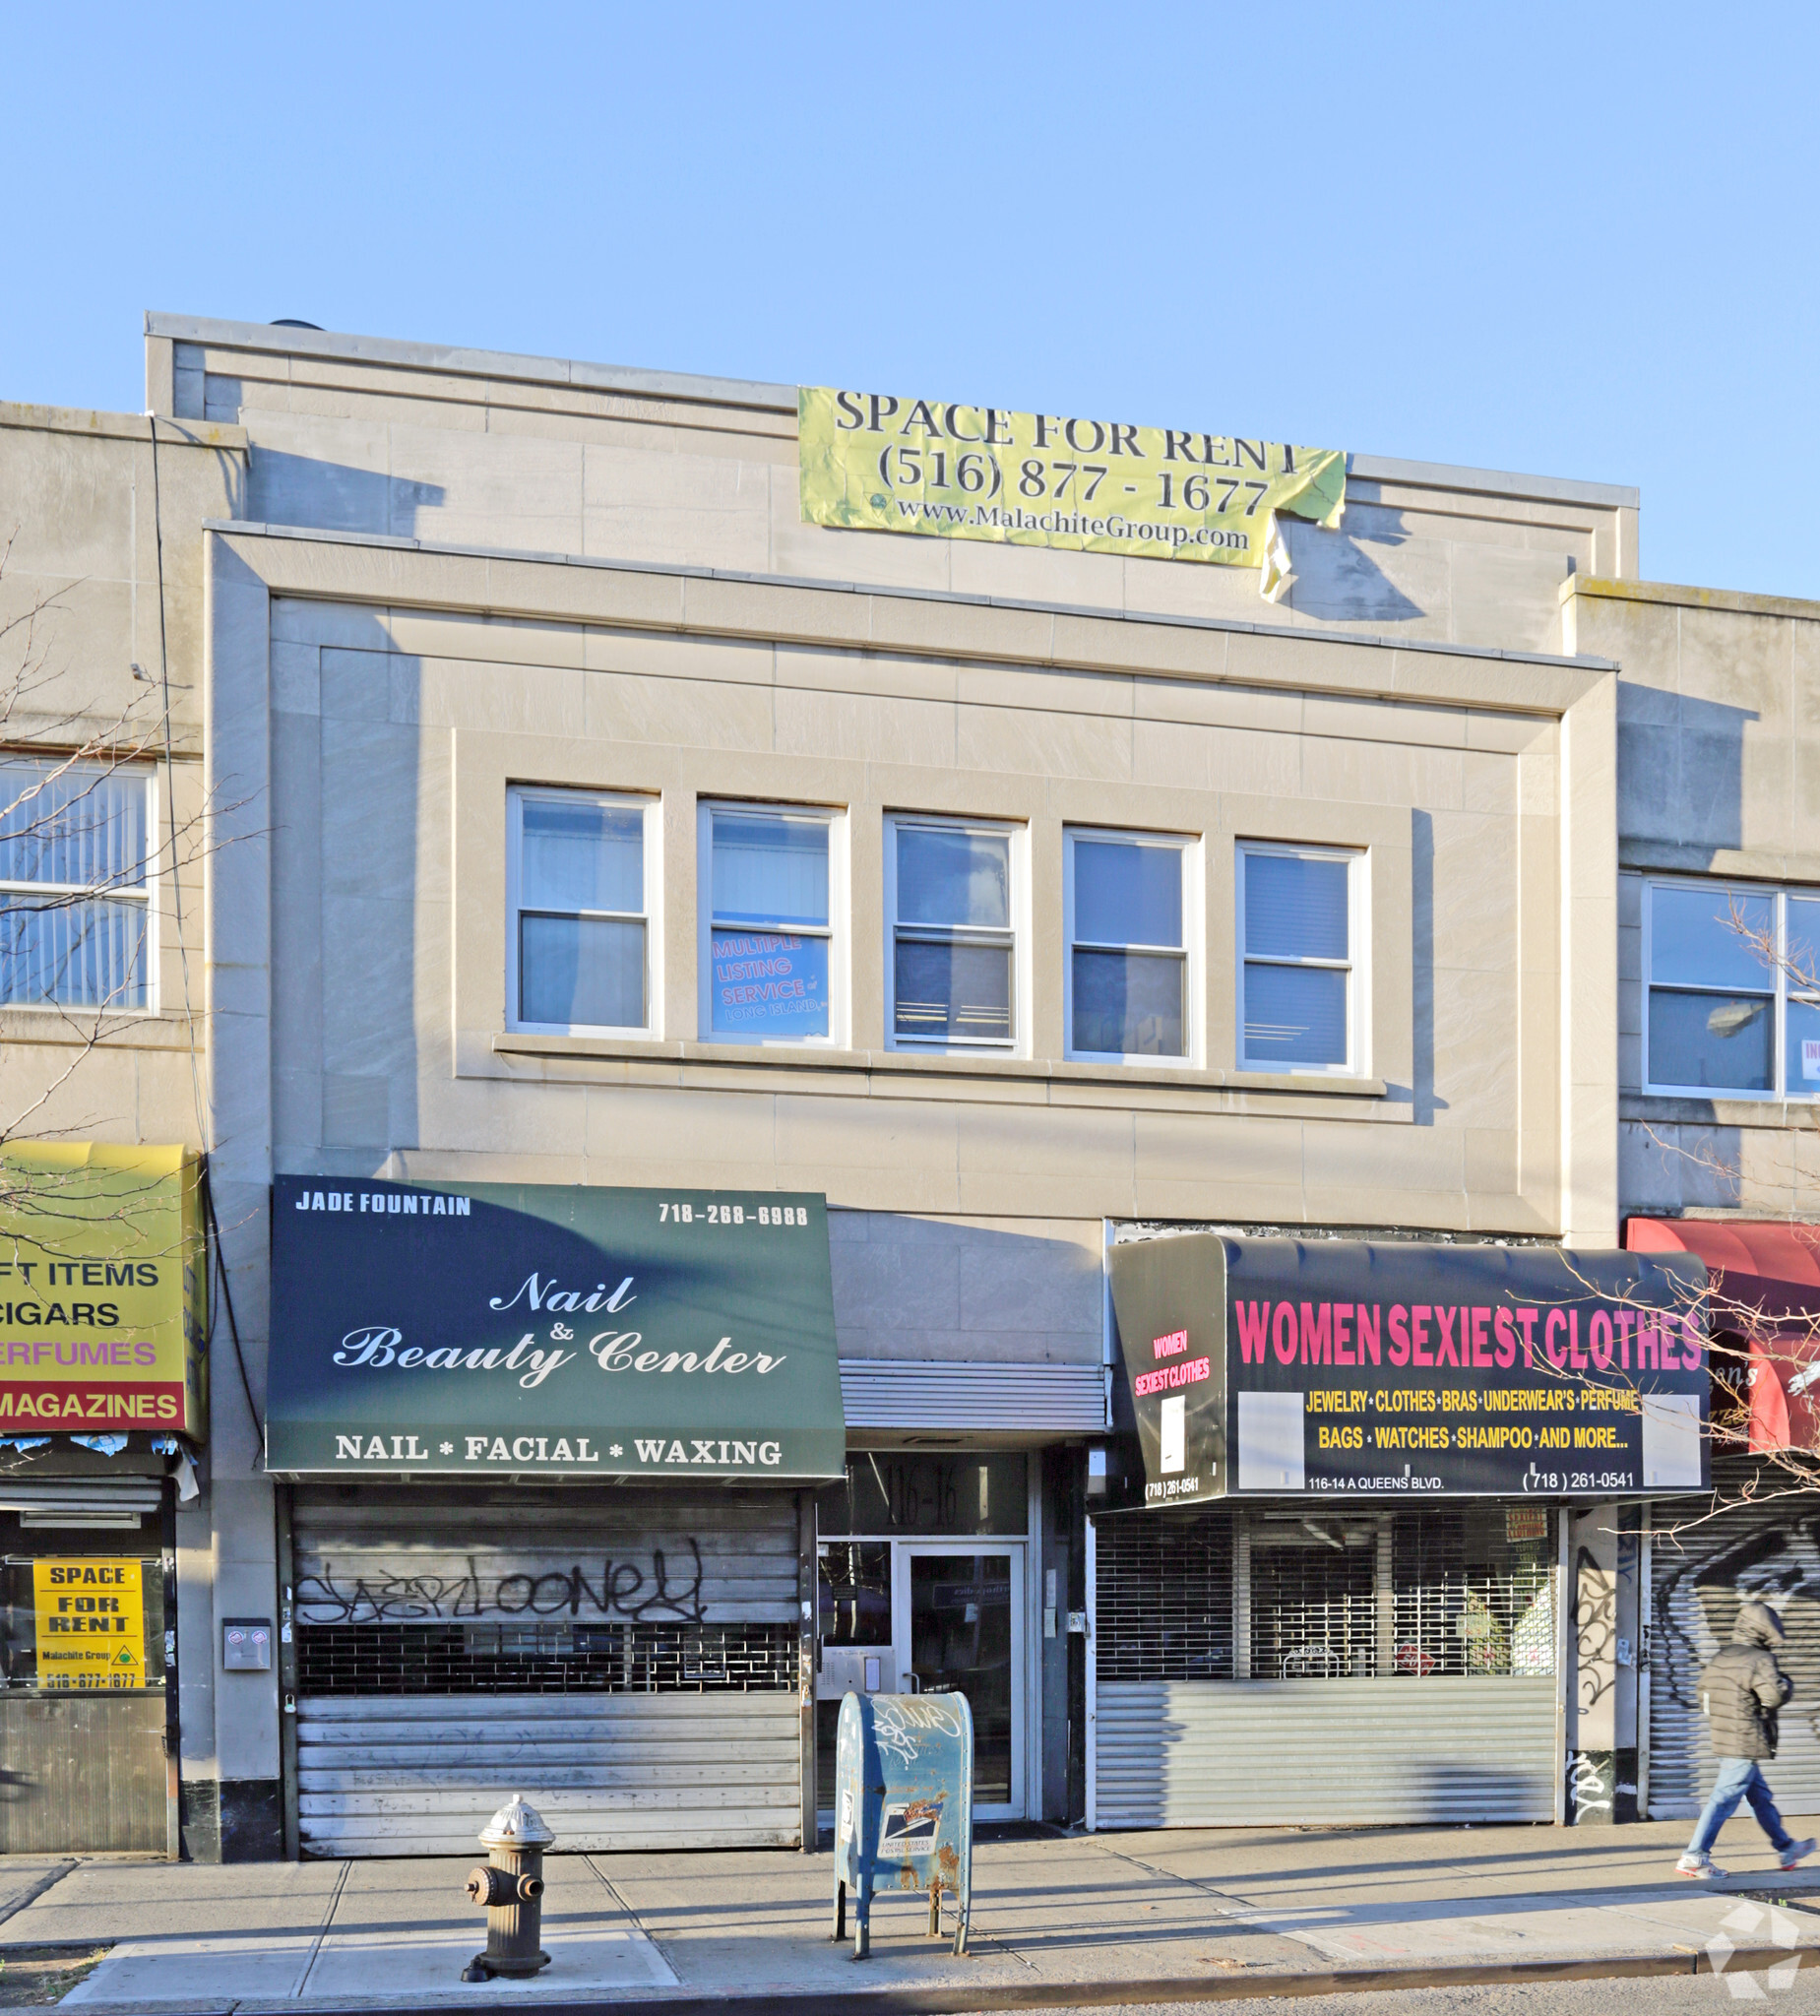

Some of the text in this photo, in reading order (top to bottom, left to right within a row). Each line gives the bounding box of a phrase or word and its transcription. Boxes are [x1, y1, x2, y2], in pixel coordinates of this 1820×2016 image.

[836, 390, 1306, 474] SPACE FOR RENT
[878, 443, 1002, 499] (516)
[1019, 459, 1108, 501] 877
[1156, 472, 1270, 517] 1677
[897, 497, 1250, 550] www.MalachiteGroup.com
[712, 933, 802, 959] MULTIPLE
[717, 957, 792, 982] LISTING
[722, 978, 805, 1006] SERVICE
[724, 1005, 766, 1022] LONG
[295, 1191, 471, 1216] JADE FOUNTAIN
[659, 1203, 808, 1226] 718-268-6988
[48, 1262, 159, 1287] ITEMS
[488, 1271, 638, 1314] Nail
[0, 1301, 120, 1326] IGARS
[549, 1322, 575, 1341] &
[1153, 1329, 1188, 1359] WOMEN
[1234, 1299, 1702, 1371] WOMEN SEXIEST CLOTHES
[333, 1325, 787, 1389] Beauty Center
[1135, 1355, 1211, 1397] SEXIEST CLOTHES
[1305, 1389, 1640, 1413] JEWELRY CLOTHES BRAS UNDERWEAR'S PERFUME
[1318, 1425, 1628, 1449] BAGS WATCHES SHAMPOO AND MORE...
[335, 1435, 783, 1466] NAIL FACIAL WAXING
[1166, 1477, 1199, 1495] 261-0541
[1308, 1477, 1445, 1490] 116-14 A QUEENS BLVD.
[1571, 1472, 1634, 1488] 261-0541
[49, 1567, 126, 1584] SPACE
[57, 1597, 120, 1612] FOR
[48, 1616, 130, 1632] RENT
[42, 1651, 111, 1662] Malachite Group
